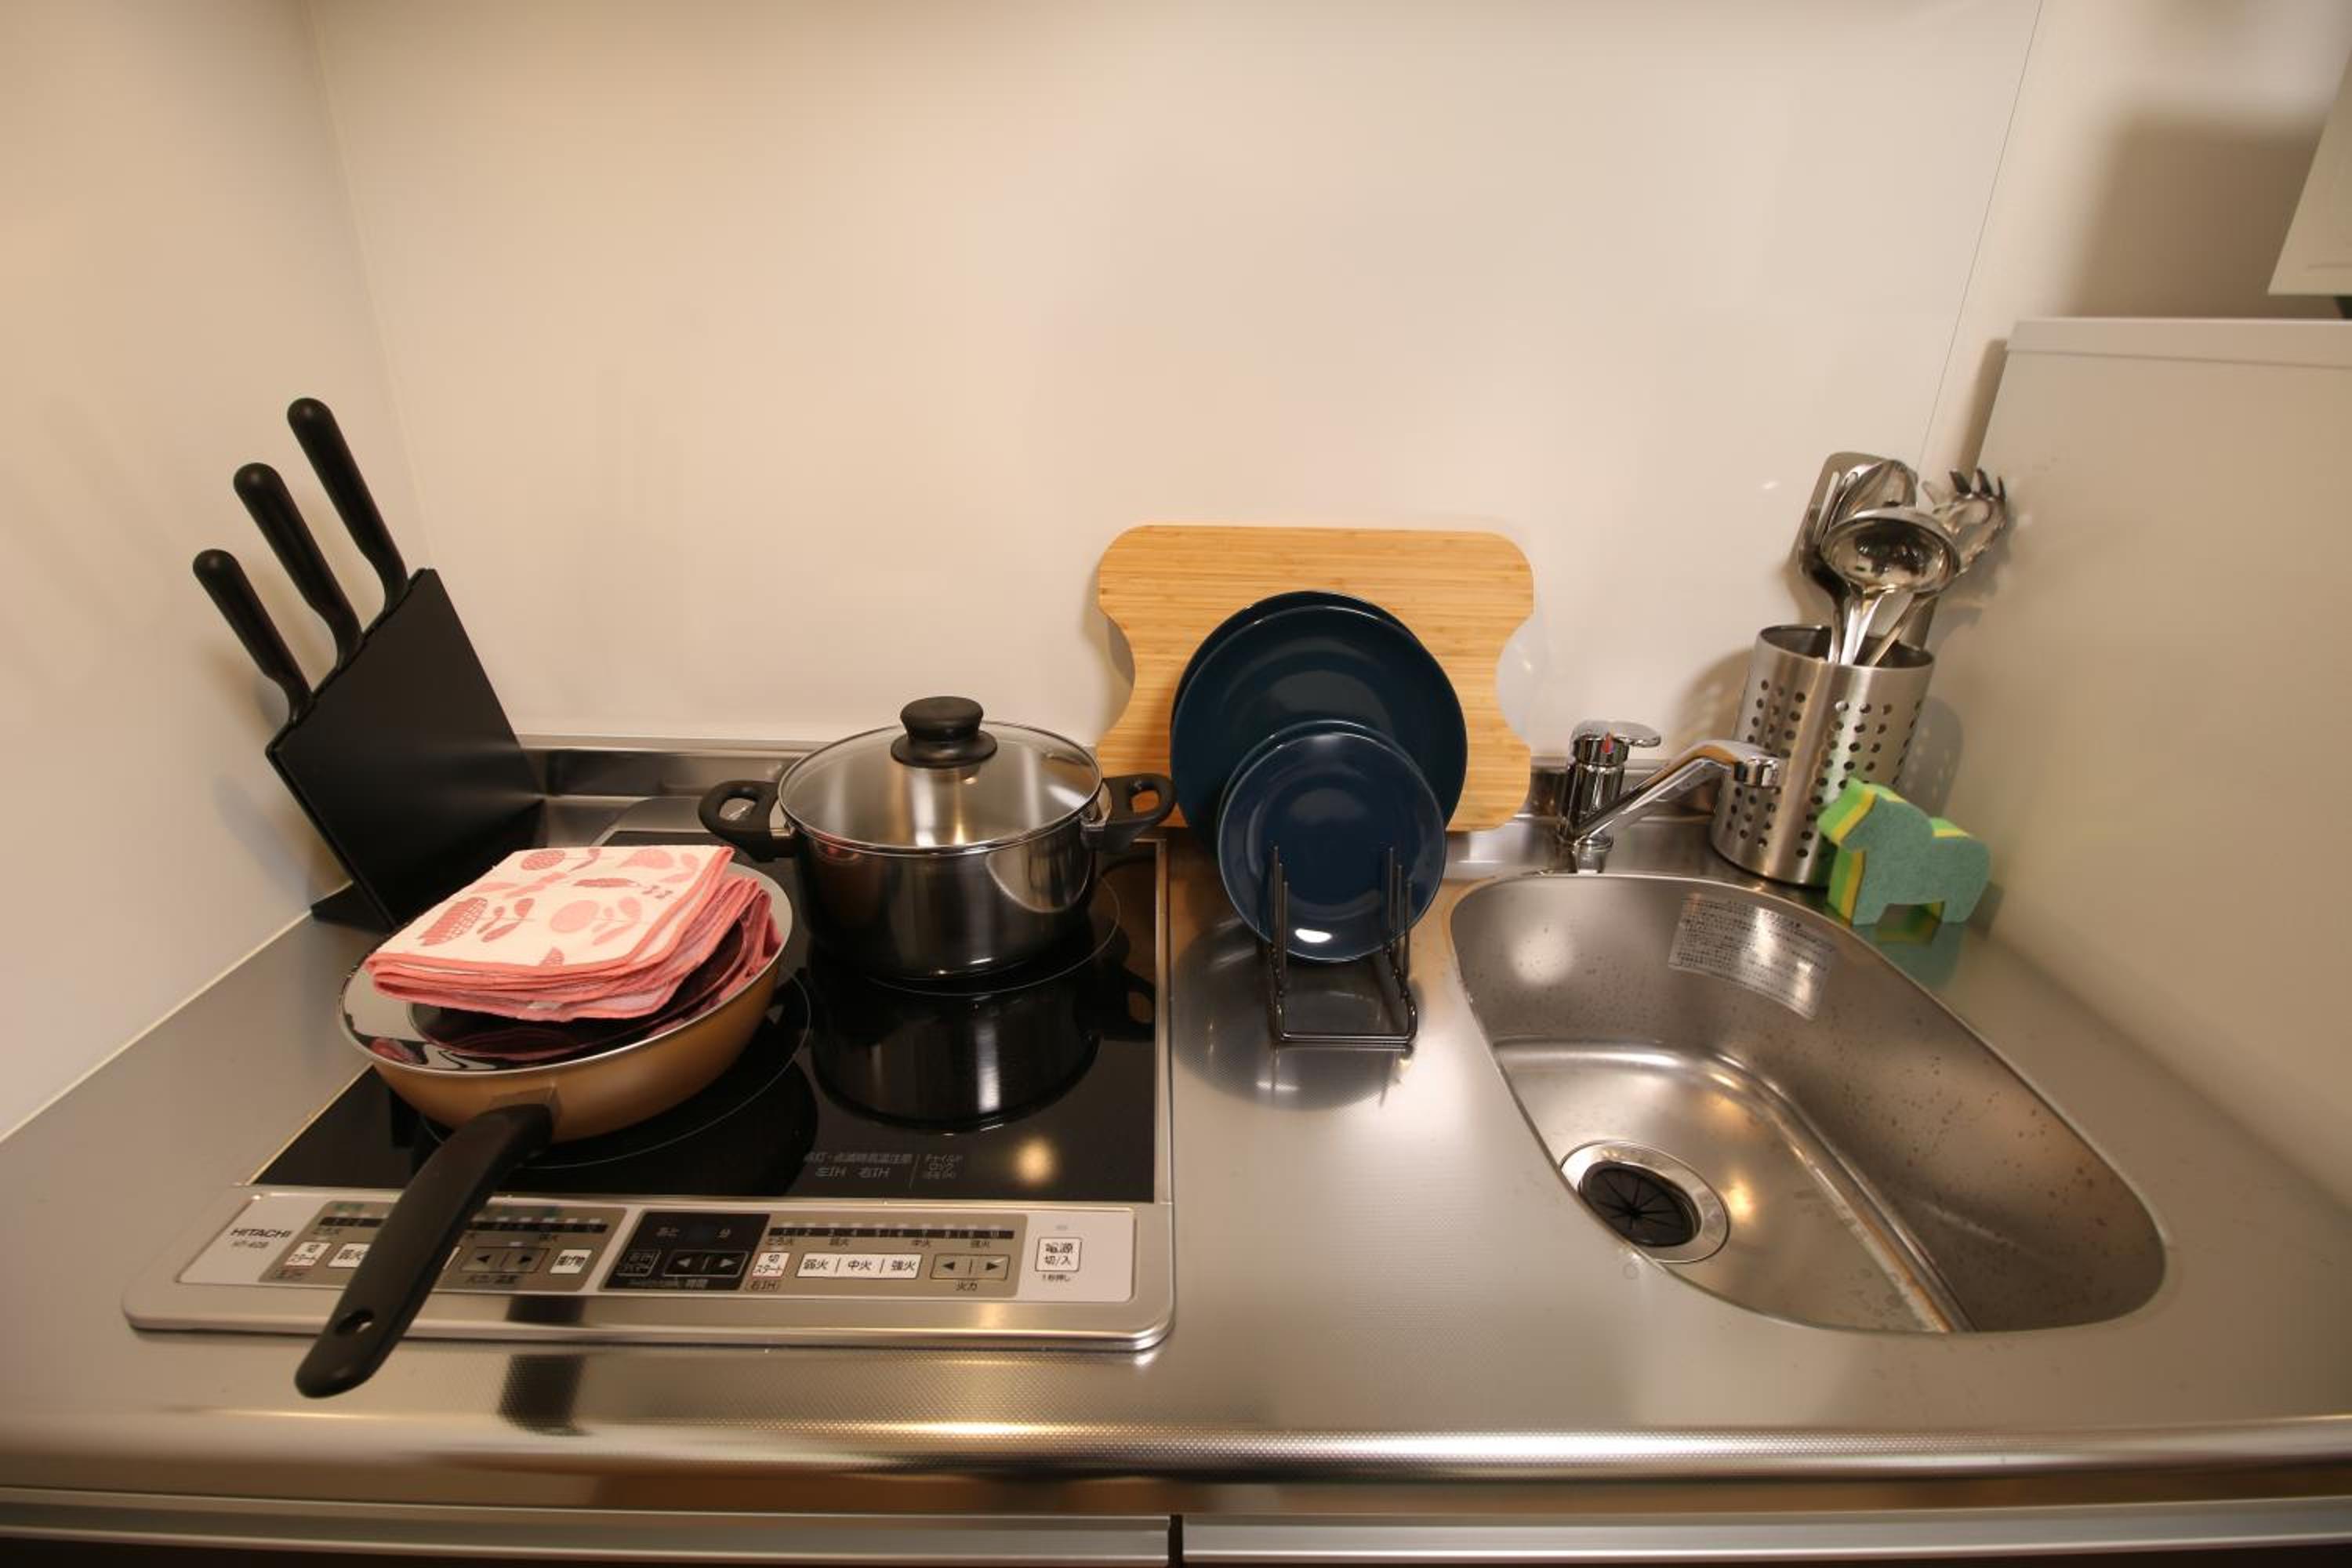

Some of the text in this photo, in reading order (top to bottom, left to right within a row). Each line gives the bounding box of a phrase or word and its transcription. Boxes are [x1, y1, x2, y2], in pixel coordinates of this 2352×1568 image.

[230, 1229, 292, 1240] HITACHI
[1045, 1242, 1073, 1254] 電源
[768, 1254, 780, 1263] 切
[1044, 1255, 1072, 1266] 切/入
[803, 1258, 916, 1271] 弱火 中火 強火
[956, 1282, 978, 1292] 火力
